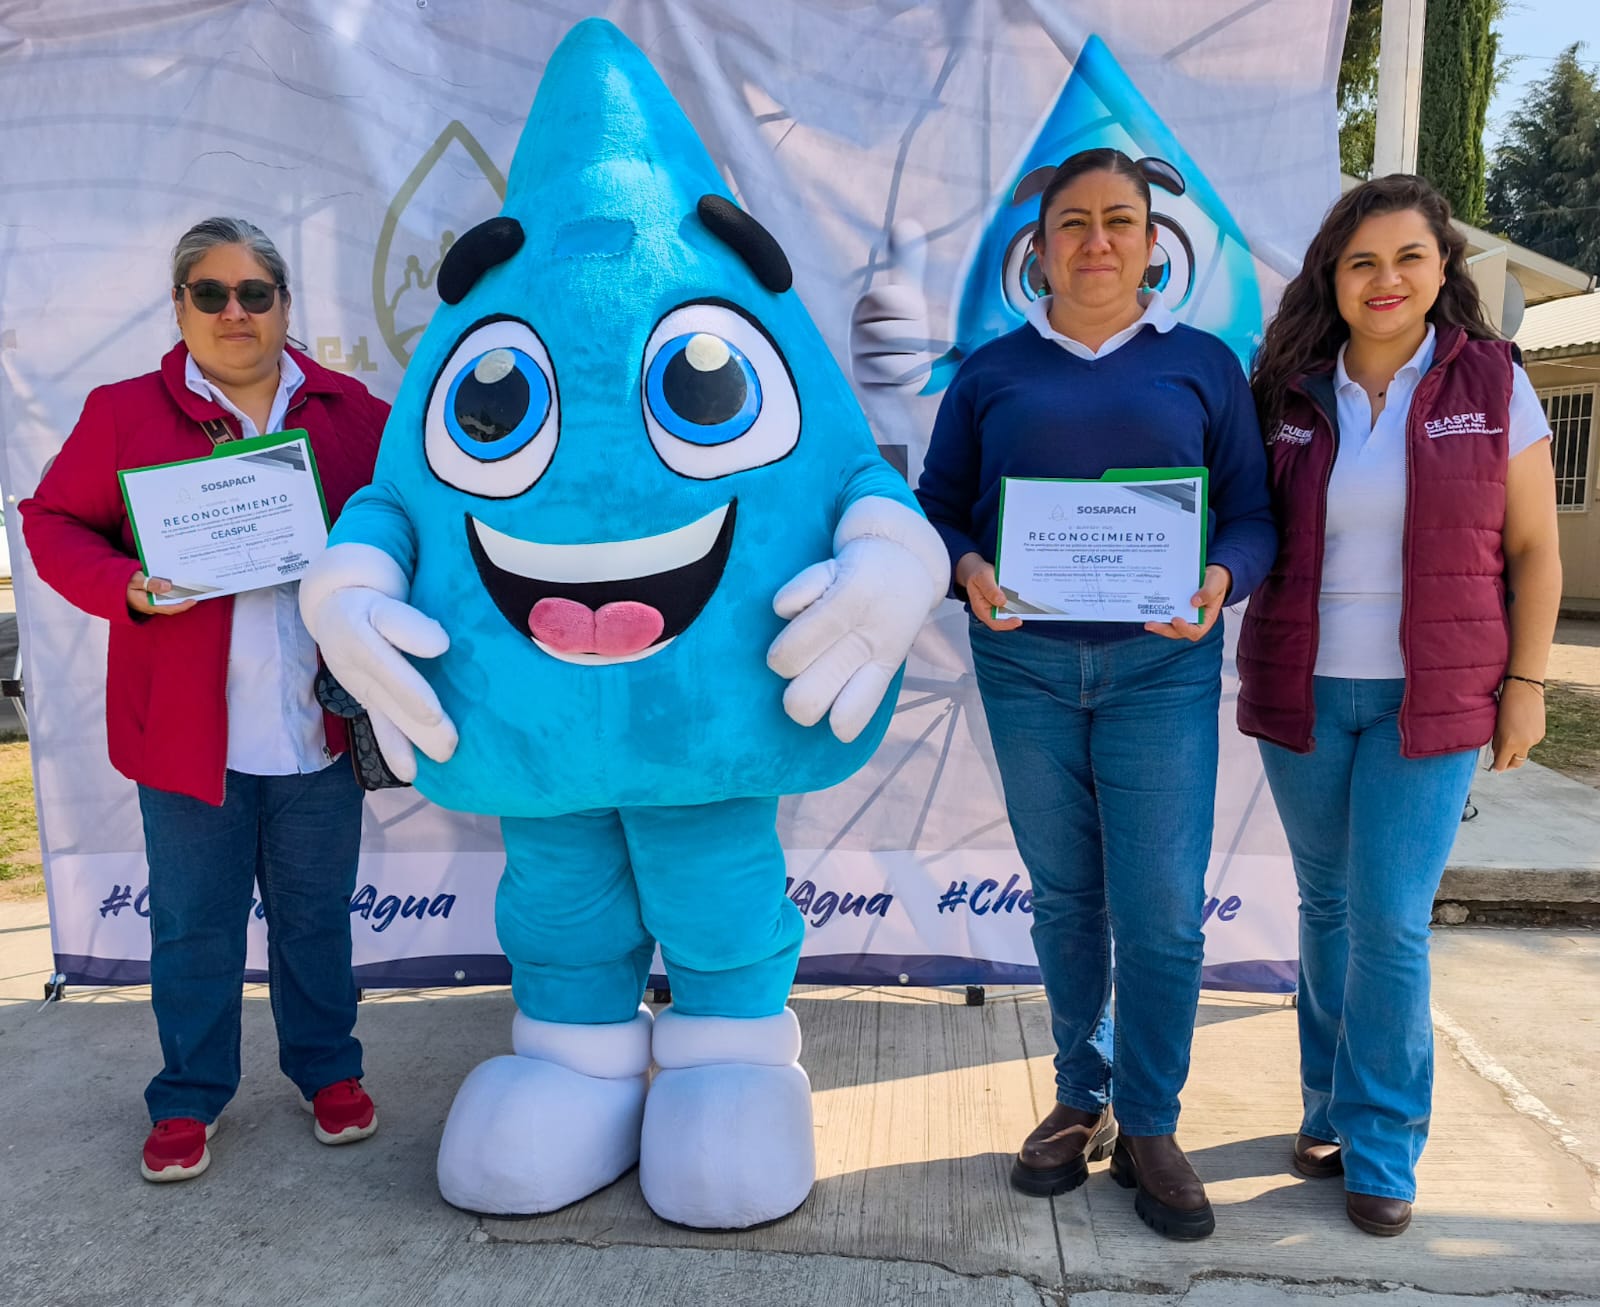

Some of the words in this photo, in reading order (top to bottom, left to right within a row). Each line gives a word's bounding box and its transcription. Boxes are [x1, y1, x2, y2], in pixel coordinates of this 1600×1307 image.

[1424, 413, 1486, 430] CEASPUE
[1280, 424, 1312, 438] PUEB
[201, 475, 256, 493] SOSAPACH
[163, 494, 289, 528] RECONOCIMIENTO
[1077, 505, 1136, 515] SOSAPACH
[211, 523, 258, 540] CEASPUE
[1029, 531, 1166, 542] RECONOCIMIENTO
[1072, 554, 1123, 564] CEASPUE
[937, 873, 1035, 916] #Cho
[1200, 895, 1242, 928] ye
